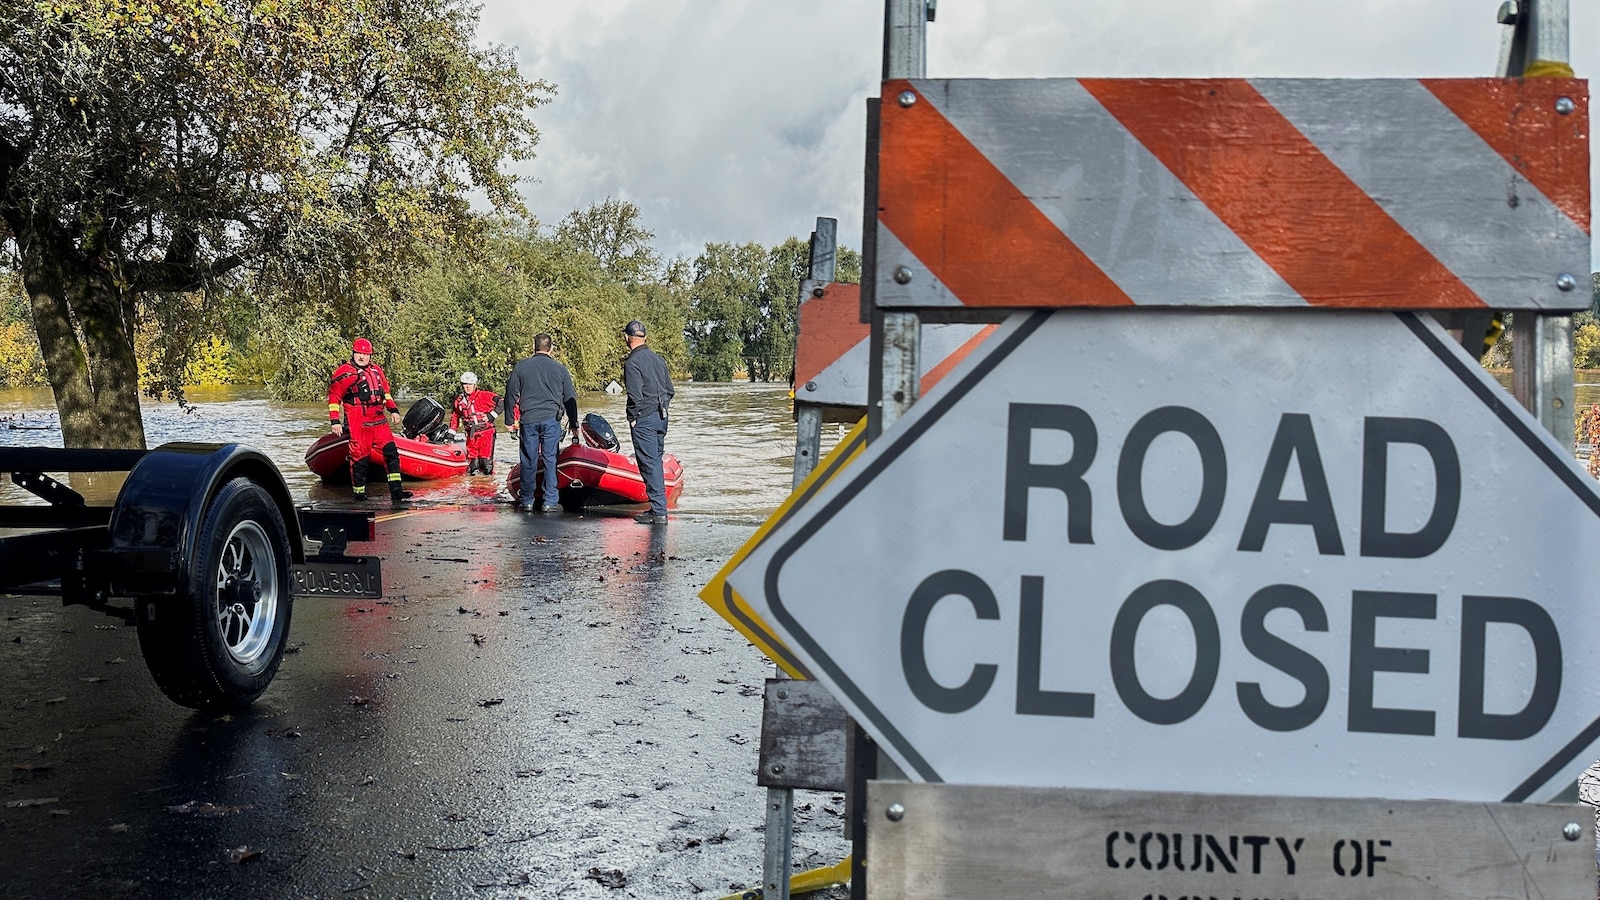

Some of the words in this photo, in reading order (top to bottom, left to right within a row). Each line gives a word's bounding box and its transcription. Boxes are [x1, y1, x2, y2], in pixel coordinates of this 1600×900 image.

[1003, 402, 1461, 559] ROAD
[899, 568, 1563, 741] CLOSED
[1105, 830, 1305, 876] COUNTY
[1332, 839, 1392, 878] OF
